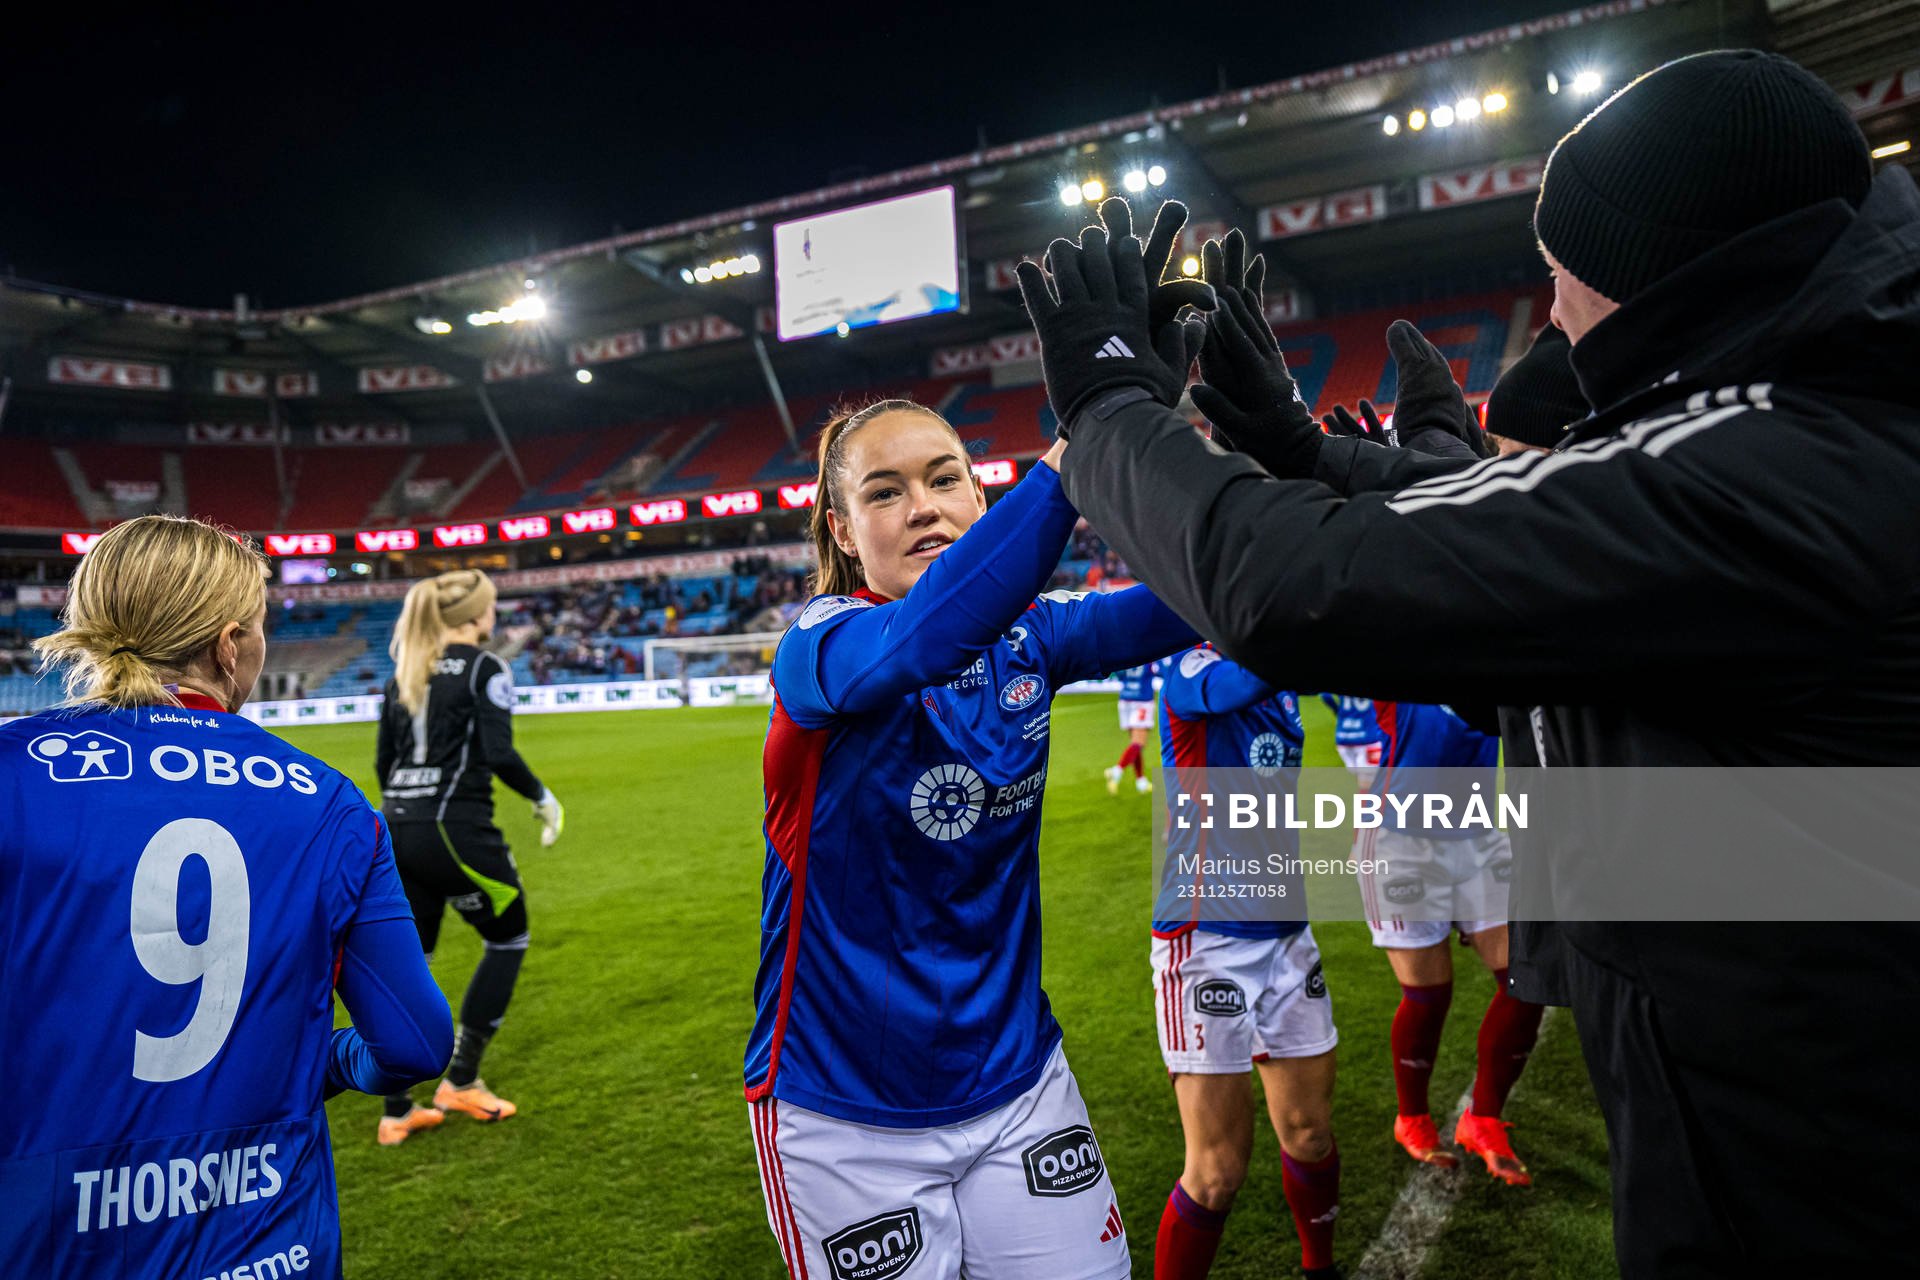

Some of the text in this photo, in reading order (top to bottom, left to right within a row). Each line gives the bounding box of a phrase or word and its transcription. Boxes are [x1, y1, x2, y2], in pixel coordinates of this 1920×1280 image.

[150, 713, 220, 728] Klubben for alle
[149, 745, 318, 795] OBOS
[989, 795, 1034, 818] FOR THE
[130, 817, 251, 1082] 9
[1201, 989, 1241, 1006] ooni
[1194, 1024, 1204, 1051] 3
[1039, 1137, 1097, 1178] ooni
[74, 1143, 282, 1232] THORSNES
[1052, 1166, 1096, 1187] PIZZA OVENS
[837, 1219, 911, 1270] ooni
[852, 1253, 906, 1278] PIZZA OVENS
